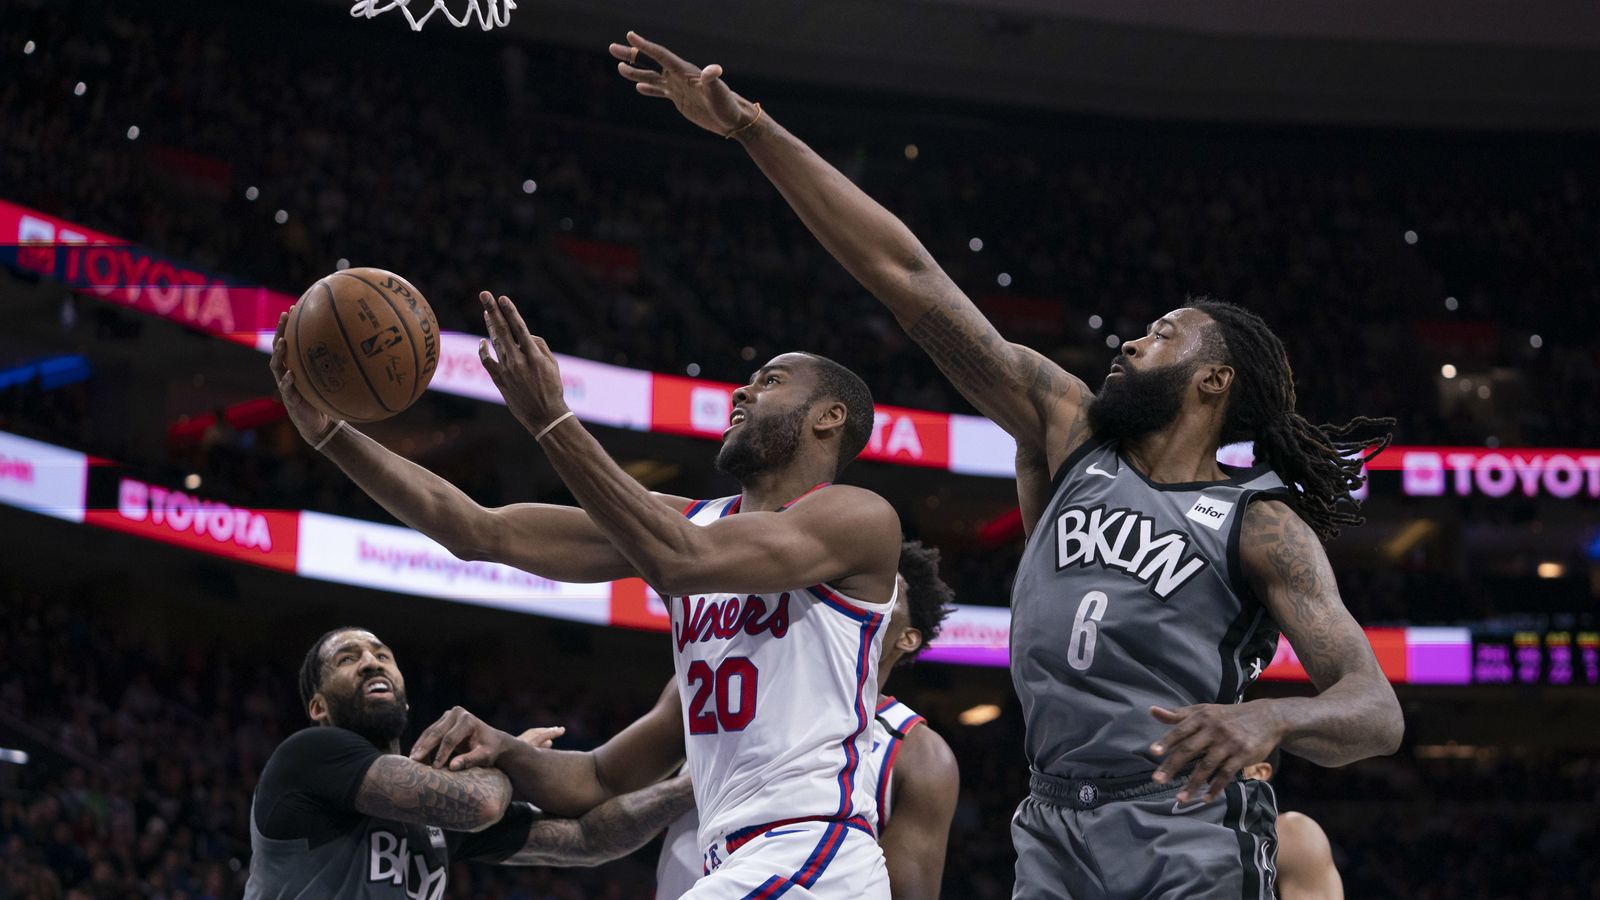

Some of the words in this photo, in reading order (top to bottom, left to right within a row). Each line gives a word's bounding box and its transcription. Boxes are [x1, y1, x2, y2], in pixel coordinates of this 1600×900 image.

[58, 228, 235, 334] TOYOTA
[380, 277, 437, 375] SPADING
[149, 484, 272, 551] TOYOTA
[1193, 503, 1225, 519] infor
[1056, 506, 1207, 601] BKLYN
[1066, 590, 1109, 671] 6
[687, 656, 759, 735] 20
